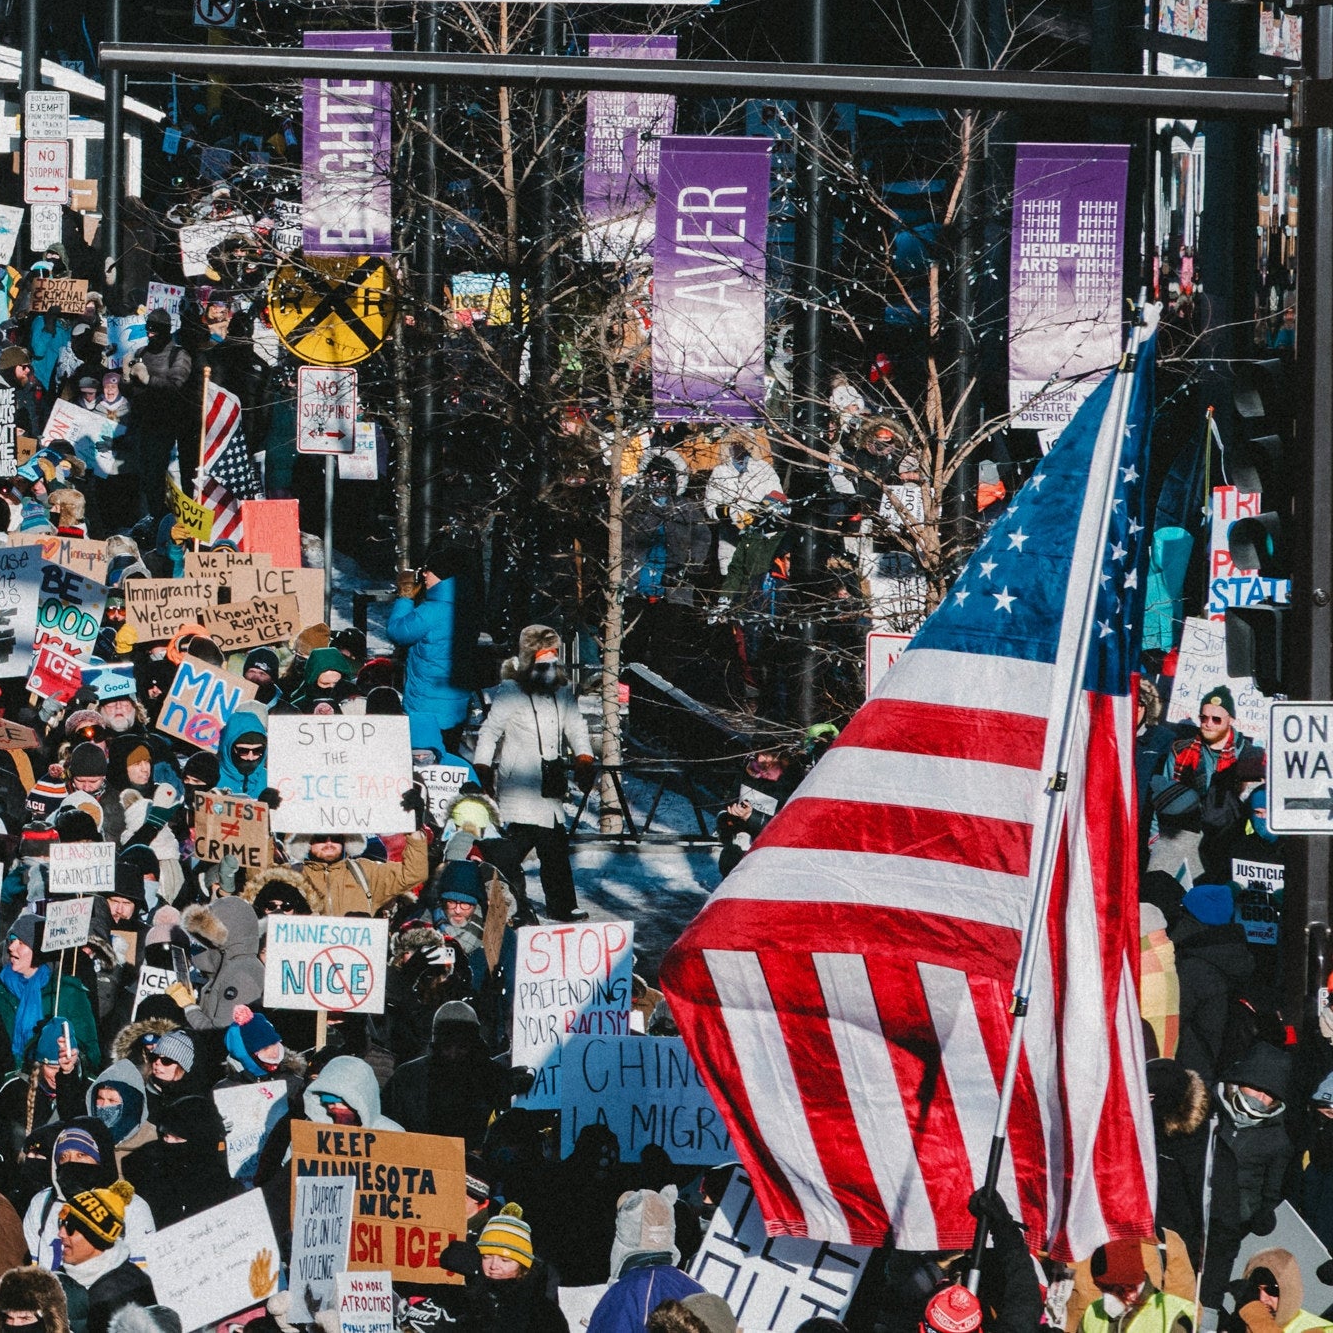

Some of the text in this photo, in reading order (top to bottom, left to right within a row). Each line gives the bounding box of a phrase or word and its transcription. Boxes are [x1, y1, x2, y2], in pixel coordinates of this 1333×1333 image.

[30, 104, 62, 113] EXEMPT
[39, 150, 55, 163] NO
[29, 168, 63, 180] STOPPING
[1019, 258, 1059, 272] ARTS
[280, 291, 302, 315] R
[316, 381, 340, 397] NO
[298, 722, 376, 746] STOP
[1283, 715, 1333, 742] ON
[322, 751, 347, 765] THE
[1285, 751, 1333, 778] WA
[321, 806, 371, 828] NOW
[275, 923, 372, 947] MINNESOTA
[525, 923, 627, 976] STOP
[281, 960, 369, 995] NICE
[520, 976, 629, 1010] PRETENDING
[521, 1010, 630, 1045] YOUR RACISM
